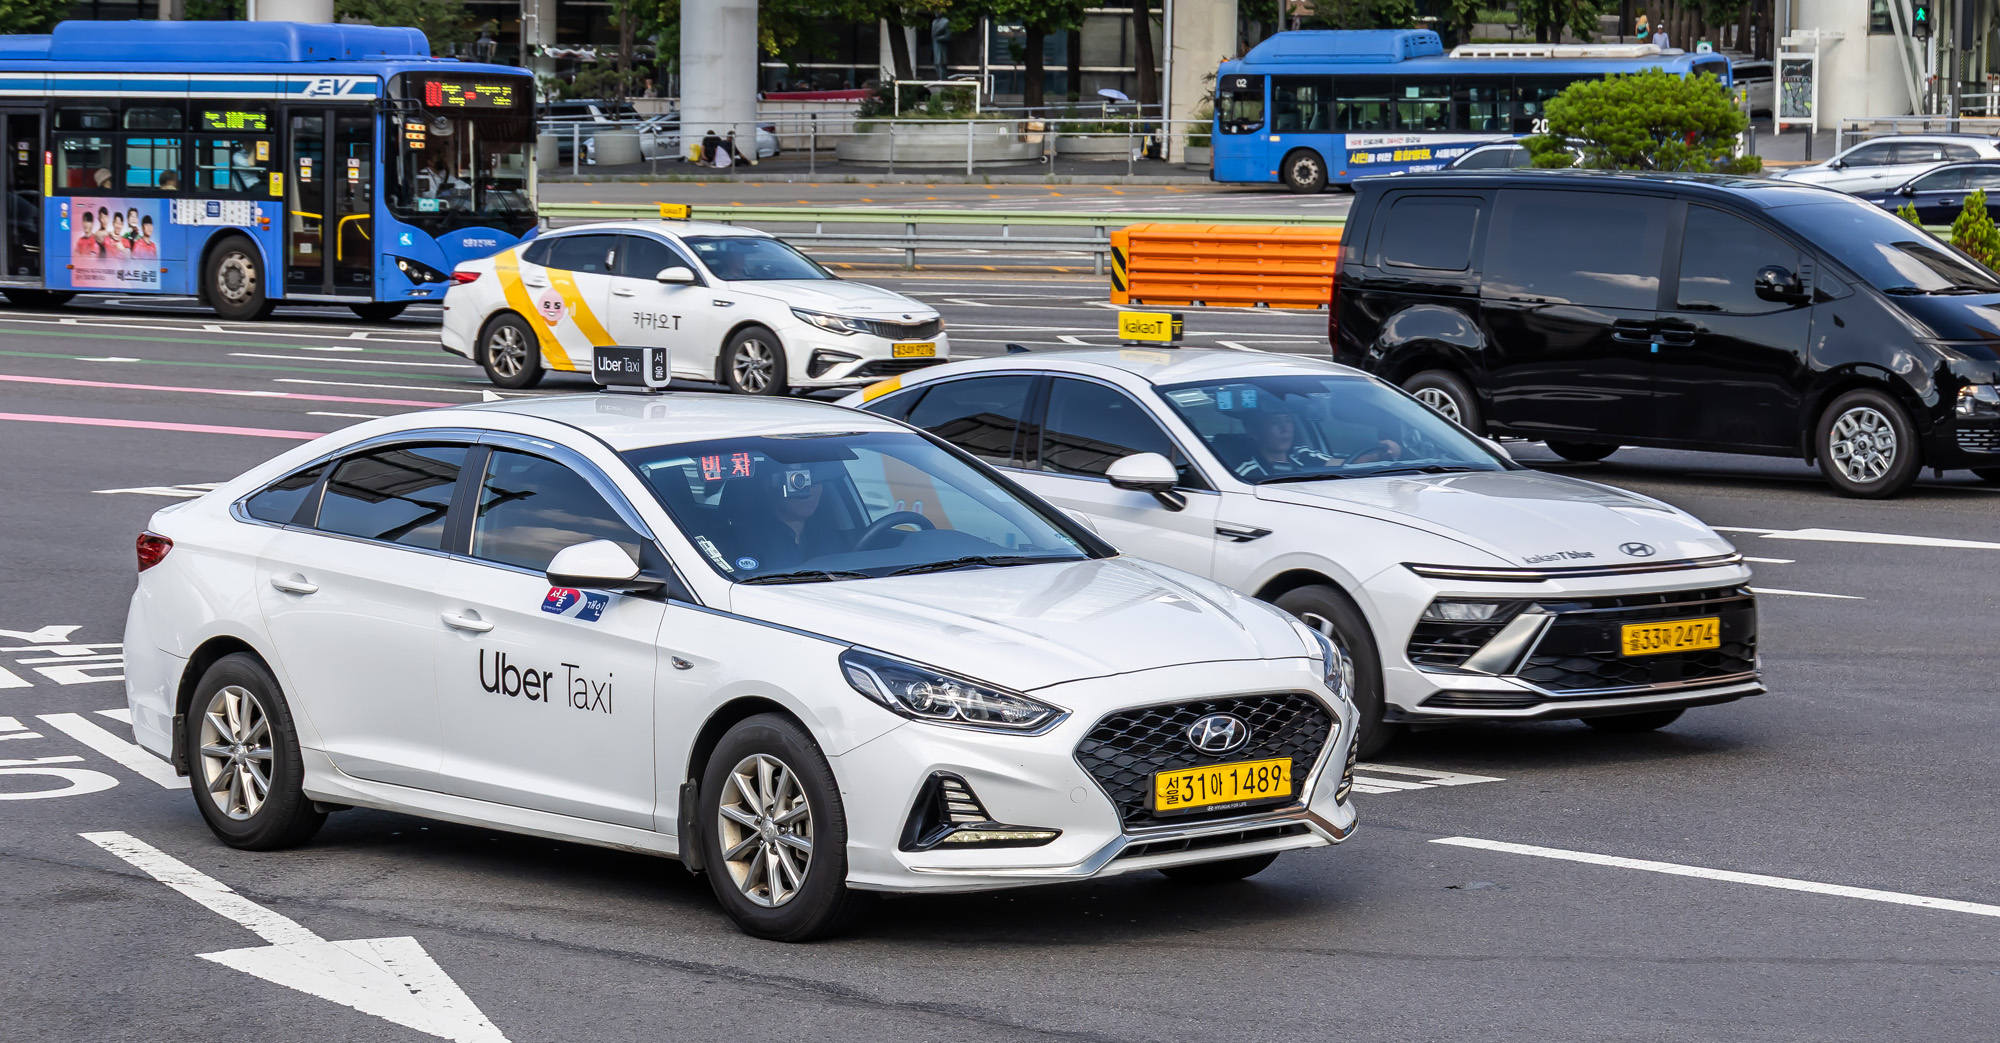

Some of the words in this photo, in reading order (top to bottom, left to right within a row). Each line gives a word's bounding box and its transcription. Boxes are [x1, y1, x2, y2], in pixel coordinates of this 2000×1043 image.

[316, 79, 350, 95] EV
[1236, 78, 1247, 88] 02
[1349, 150, 1375, 164] 시민을
[1376, 152, 1392, 162] 위한
[1435, 148, 1470, 159] 서울특별
[117, 269, 157, 283] 베스트슬립
[632, 311, 669, 330] 카카오
[672, 315, 682, 330] T
[598, 356, 622, 372] Uber
[622, 357, 640, 373] Taxi
[654, 351, 664, 379] 서울
[550, 588, 568, 607] 서울
[587, 599, 606, 617] 개인
[1674, 623, 1713, 647] 2474
[479, 648, 553, 703] Uber
[560, 662, 613, 715] Taxi
[1230, 764, 1282, 796] 1489
